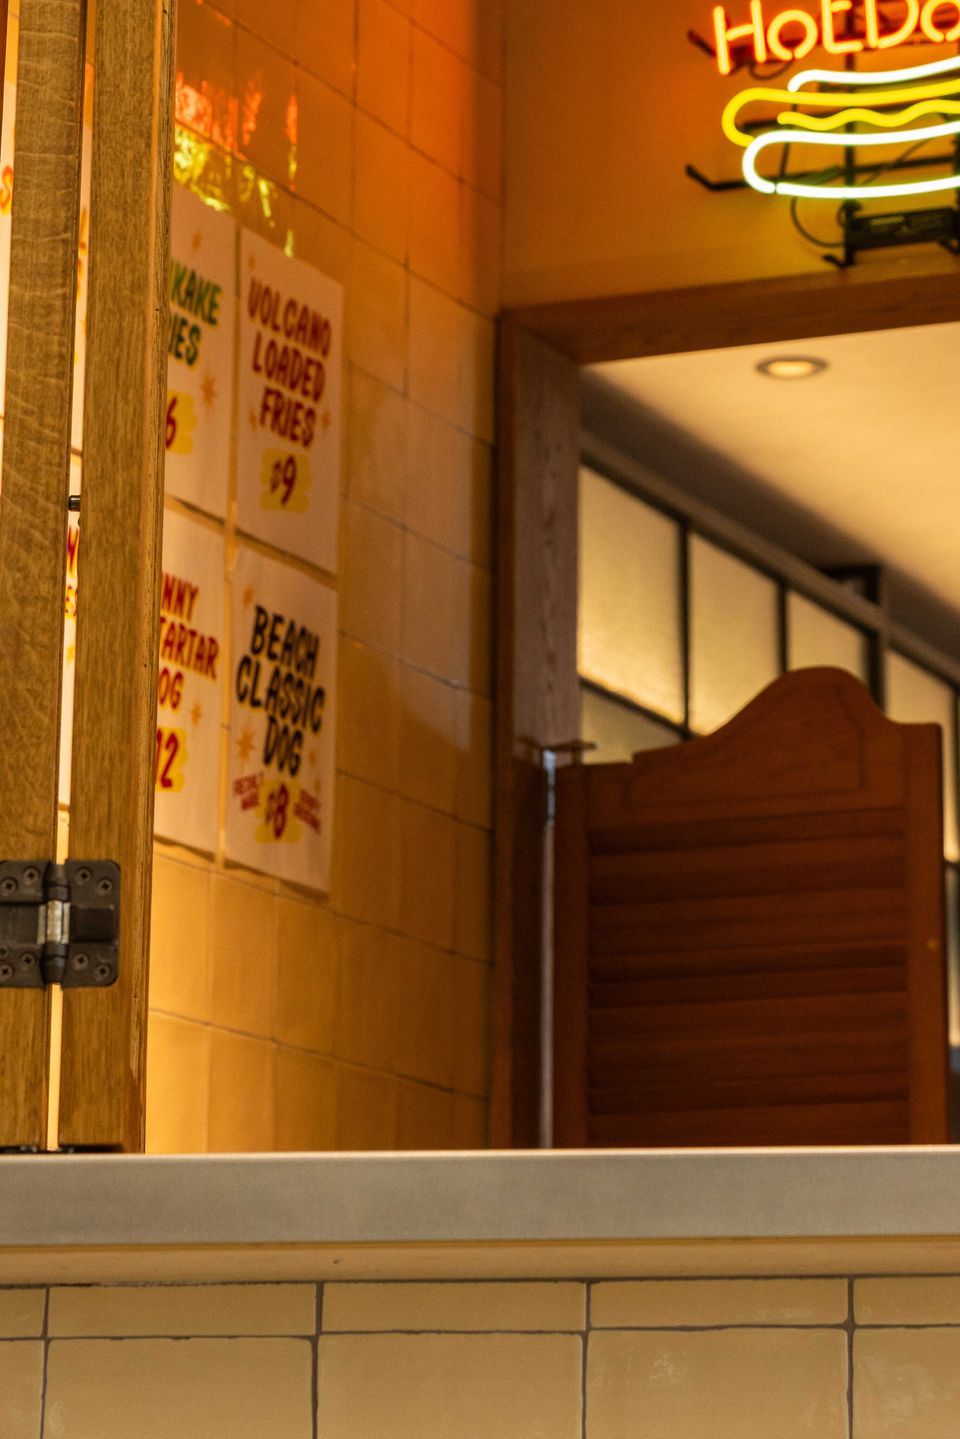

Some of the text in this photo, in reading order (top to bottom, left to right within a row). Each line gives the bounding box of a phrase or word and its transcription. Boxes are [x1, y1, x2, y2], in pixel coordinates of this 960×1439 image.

[168, 313, 201, 366] IES
[247, 276, 332, 358] VOLCANO
[252, 331, 326, 403] LOADED
[165, 396, 177, 449] 6
[260, 385, 317, 448] FRIES
[161, 572, 198, 622] NNY
[251, 604, 320, 680] BEACH
[159, 667, 183, 710] OG
[236, 655, 325, 734] CLASSIC
[156, 728, 179, 788] 12
[264, 713, 303, 777] DOG
